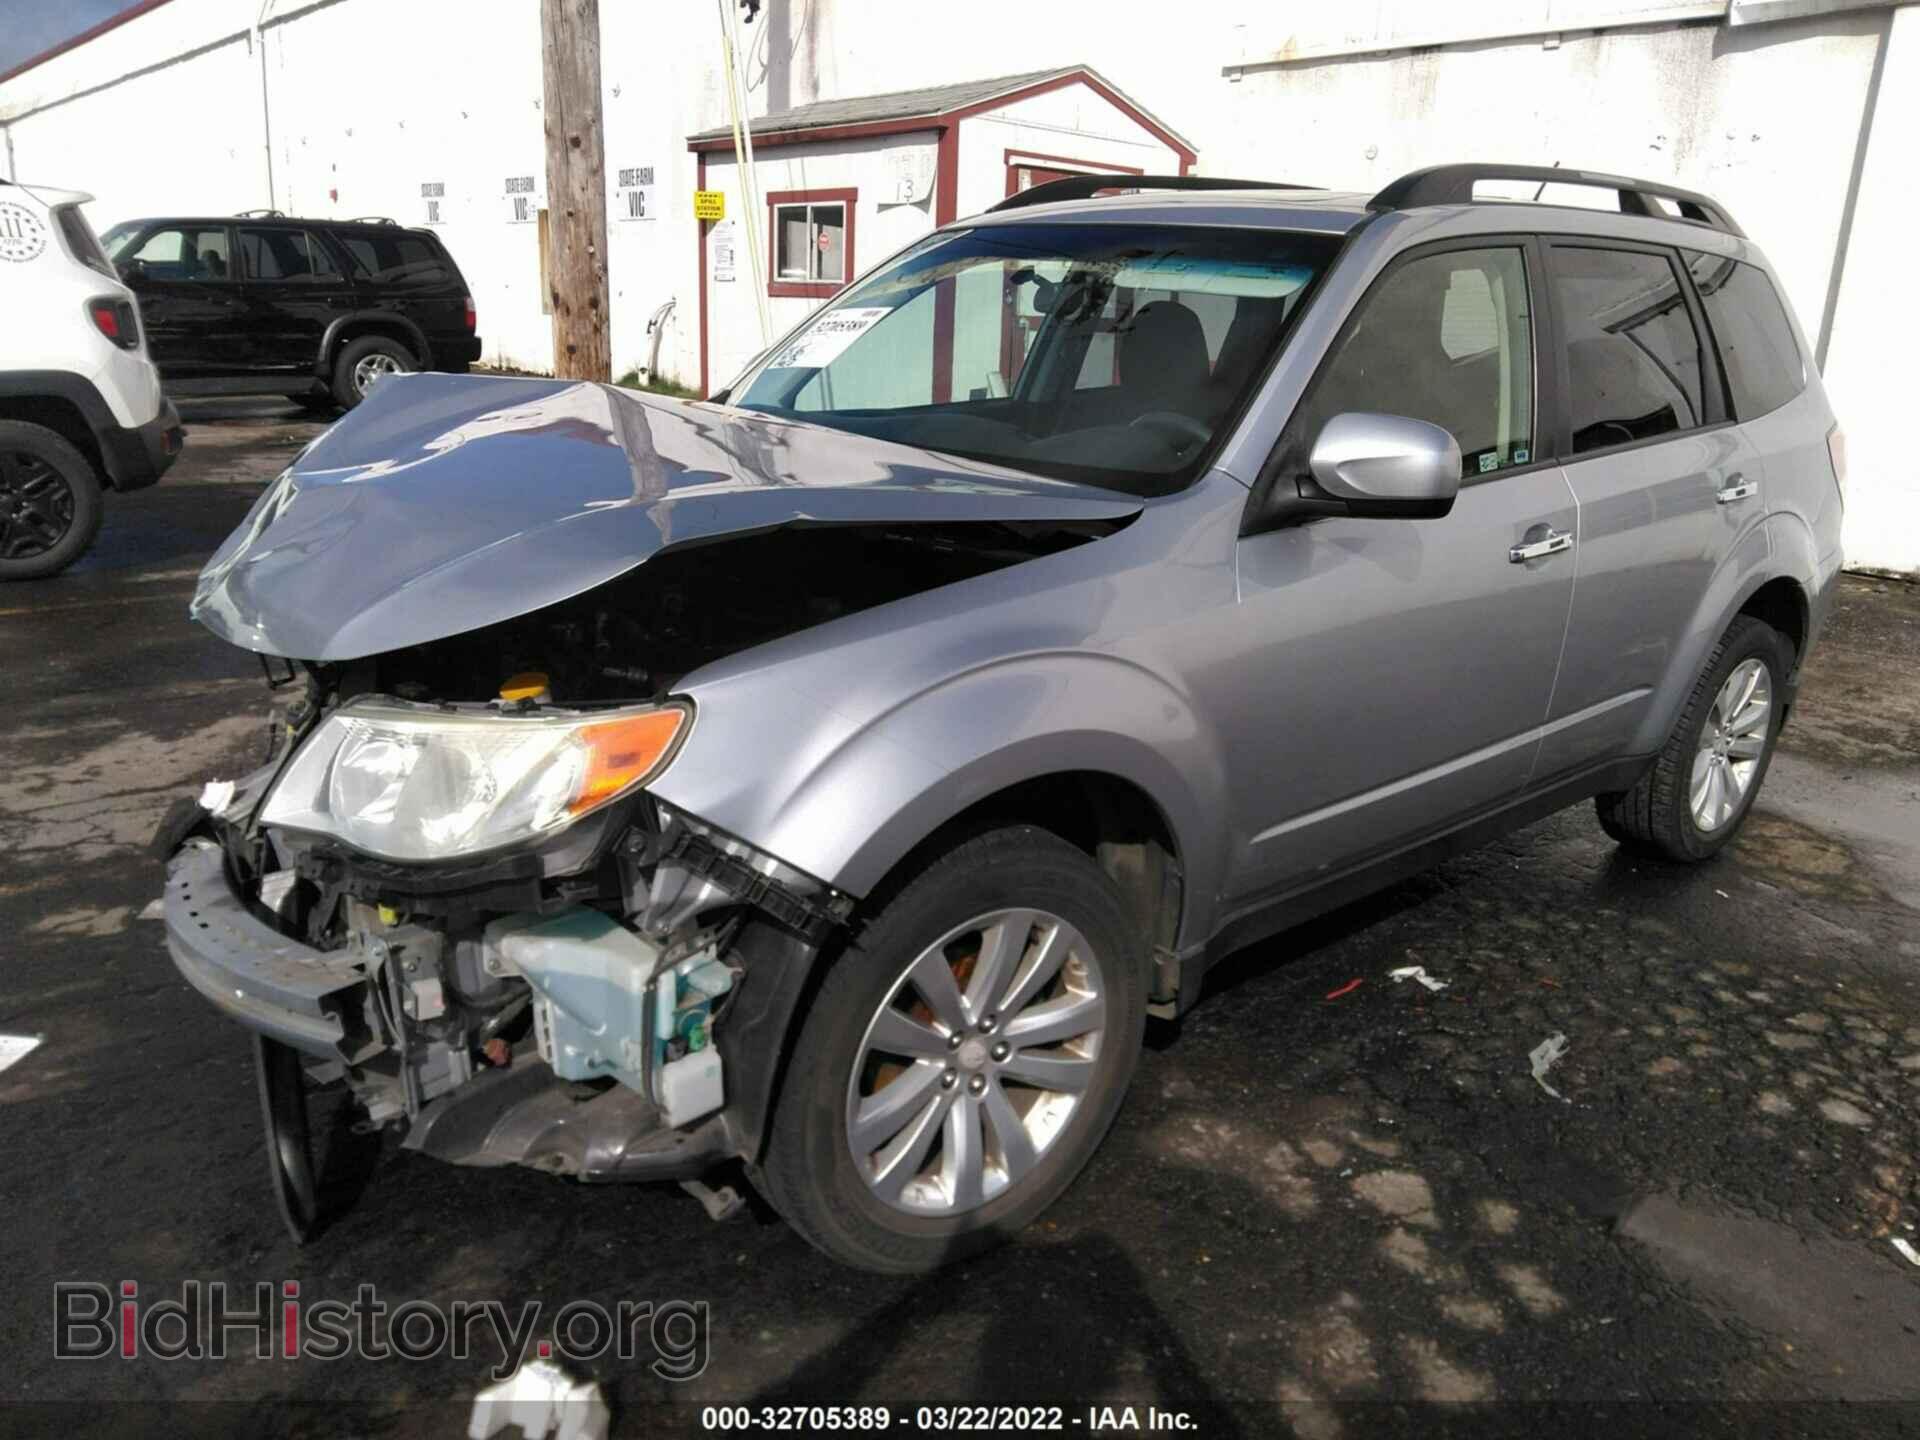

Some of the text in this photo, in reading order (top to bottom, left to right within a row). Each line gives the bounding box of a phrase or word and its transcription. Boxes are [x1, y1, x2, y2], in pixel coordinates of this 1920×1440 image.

[505, 177, 535, 194] STATE FARM
[619, 167, 654, 187] STATE FARM
[428, 201, 440, 221] VIC
[514, 197, 528, 220] VIC
[628, 191, 646, 218] VIC
